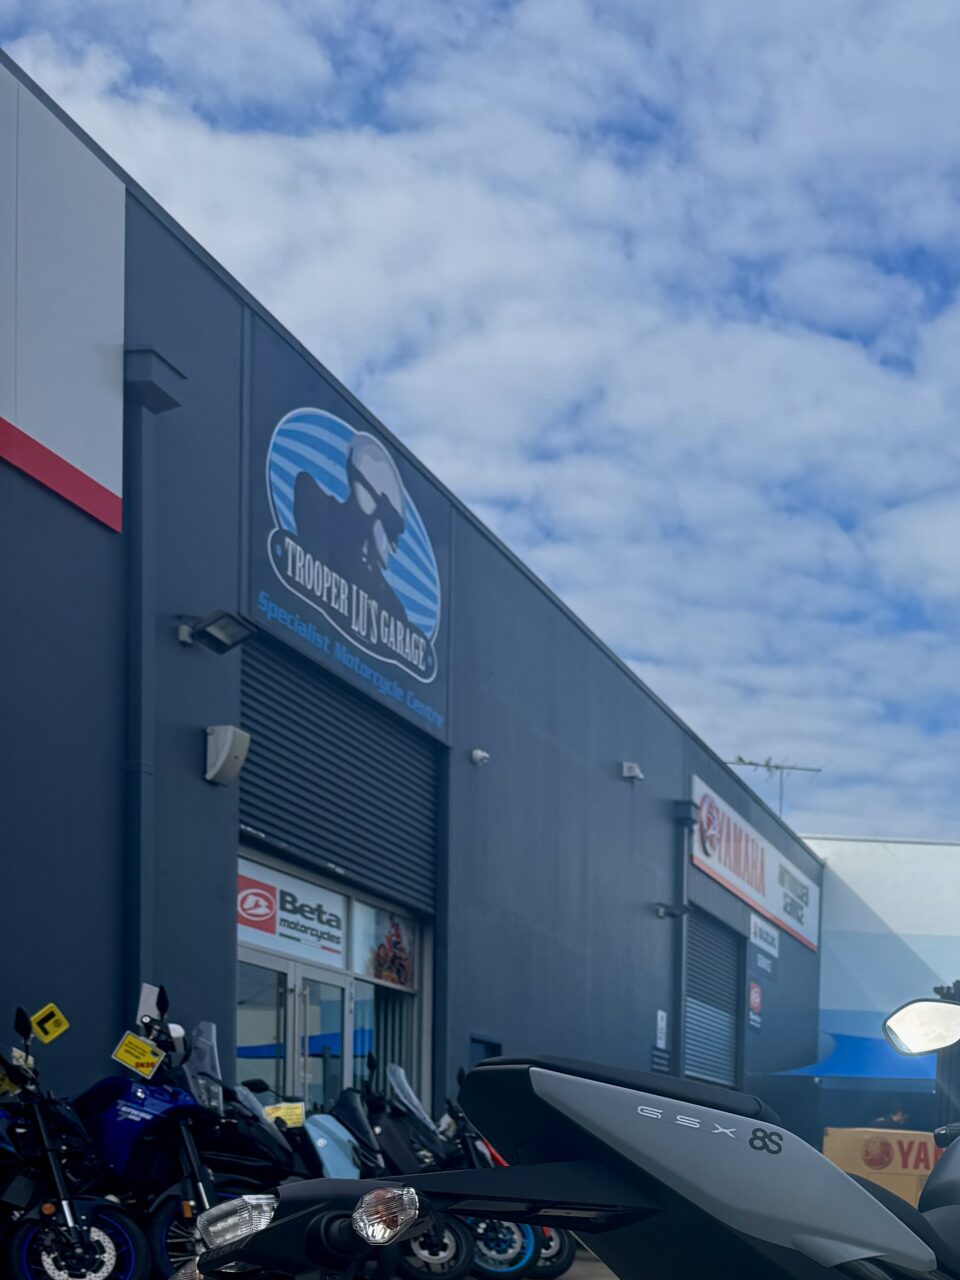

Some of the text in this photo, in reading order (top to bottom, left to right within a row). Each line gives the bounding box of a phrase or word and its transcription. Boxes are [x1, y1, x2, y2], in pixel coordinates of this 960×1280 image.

[284, 536, 427, 672] TROOPER LU'S GARAGE
[257, 591, 445, 728] Specialist Motorcycle Centre
[717, 806, 766, 897] YAMAHA
[279, 889, 342, 931] Beta
[279, 917, 342, 945] motorcycles
[749, 1127, 783, 1155] 8S
